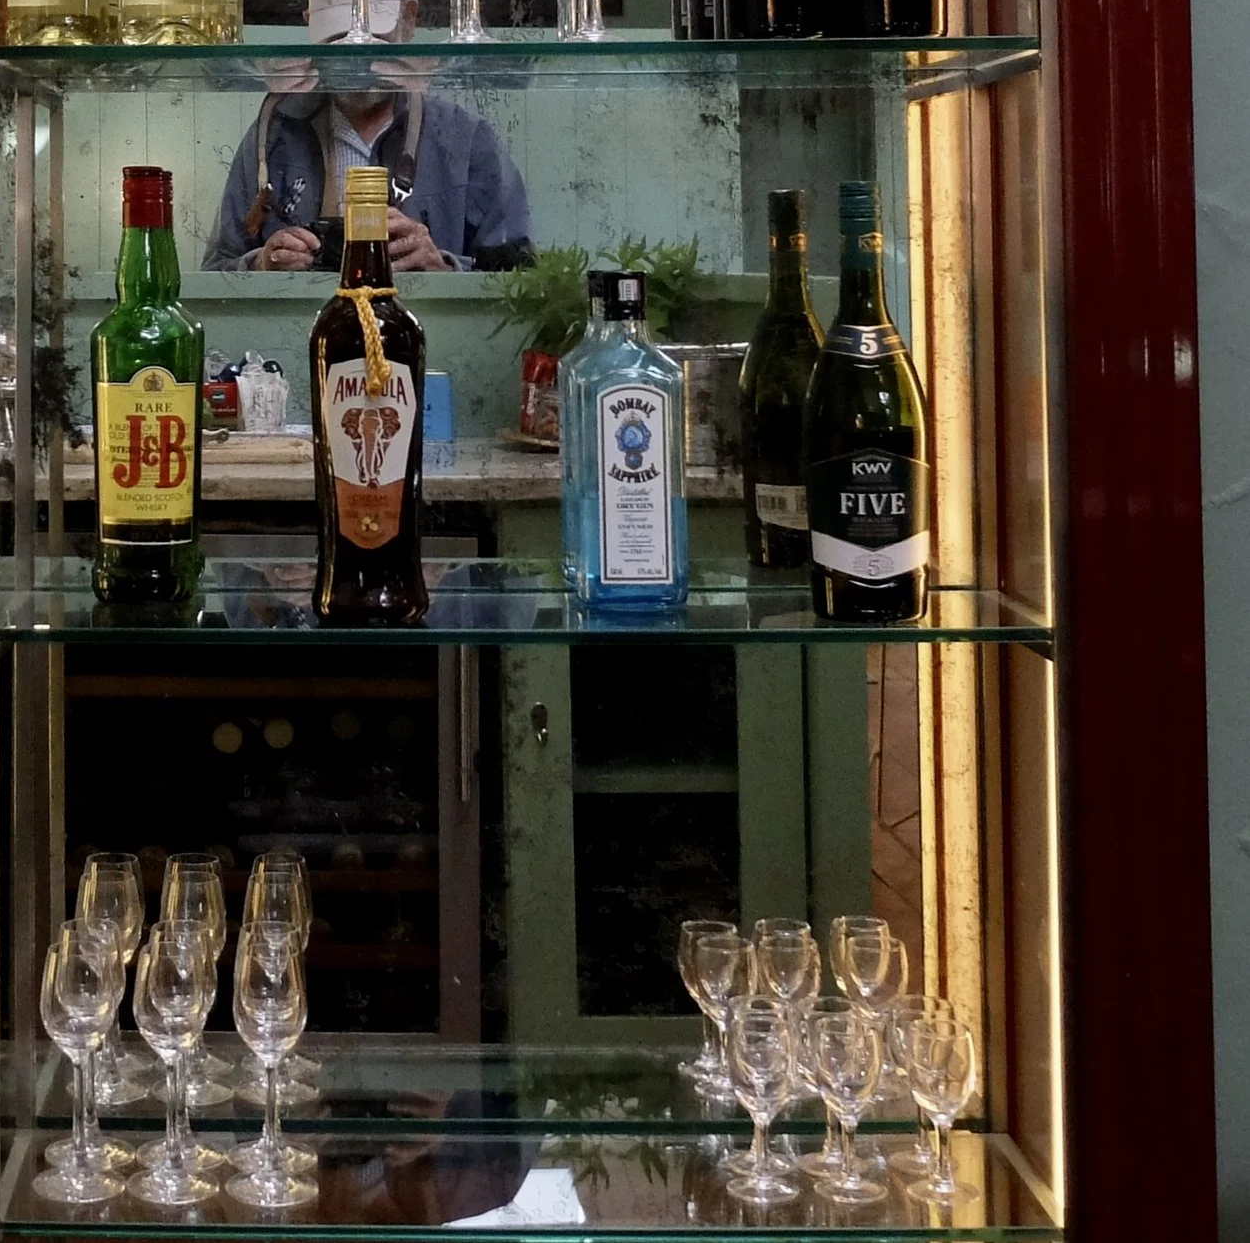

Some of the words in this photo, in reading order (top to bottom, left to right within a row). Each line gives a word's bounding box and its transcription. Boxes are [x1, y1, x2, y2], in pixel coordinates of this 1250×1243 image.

[860, 332, 878, 354] 5
[332, 375, 408, 406] AMAULA
[134, 402, 173, 413] RARE
[609, 397, 656, 418] BOMBAY
[112, 414, 188, 489] J&B
[608, 463, 661, 483] SAPPHIRE
[852, 462, 892, 475] KWV
[116, 492, 152, 502] BLENDED
[154, 492, 183, 502] SCOTCH
[135, 503, 168, 511] WHISKY
[839, 492, 906, 516] FIVE
[867, 559, 880, 577] 5
